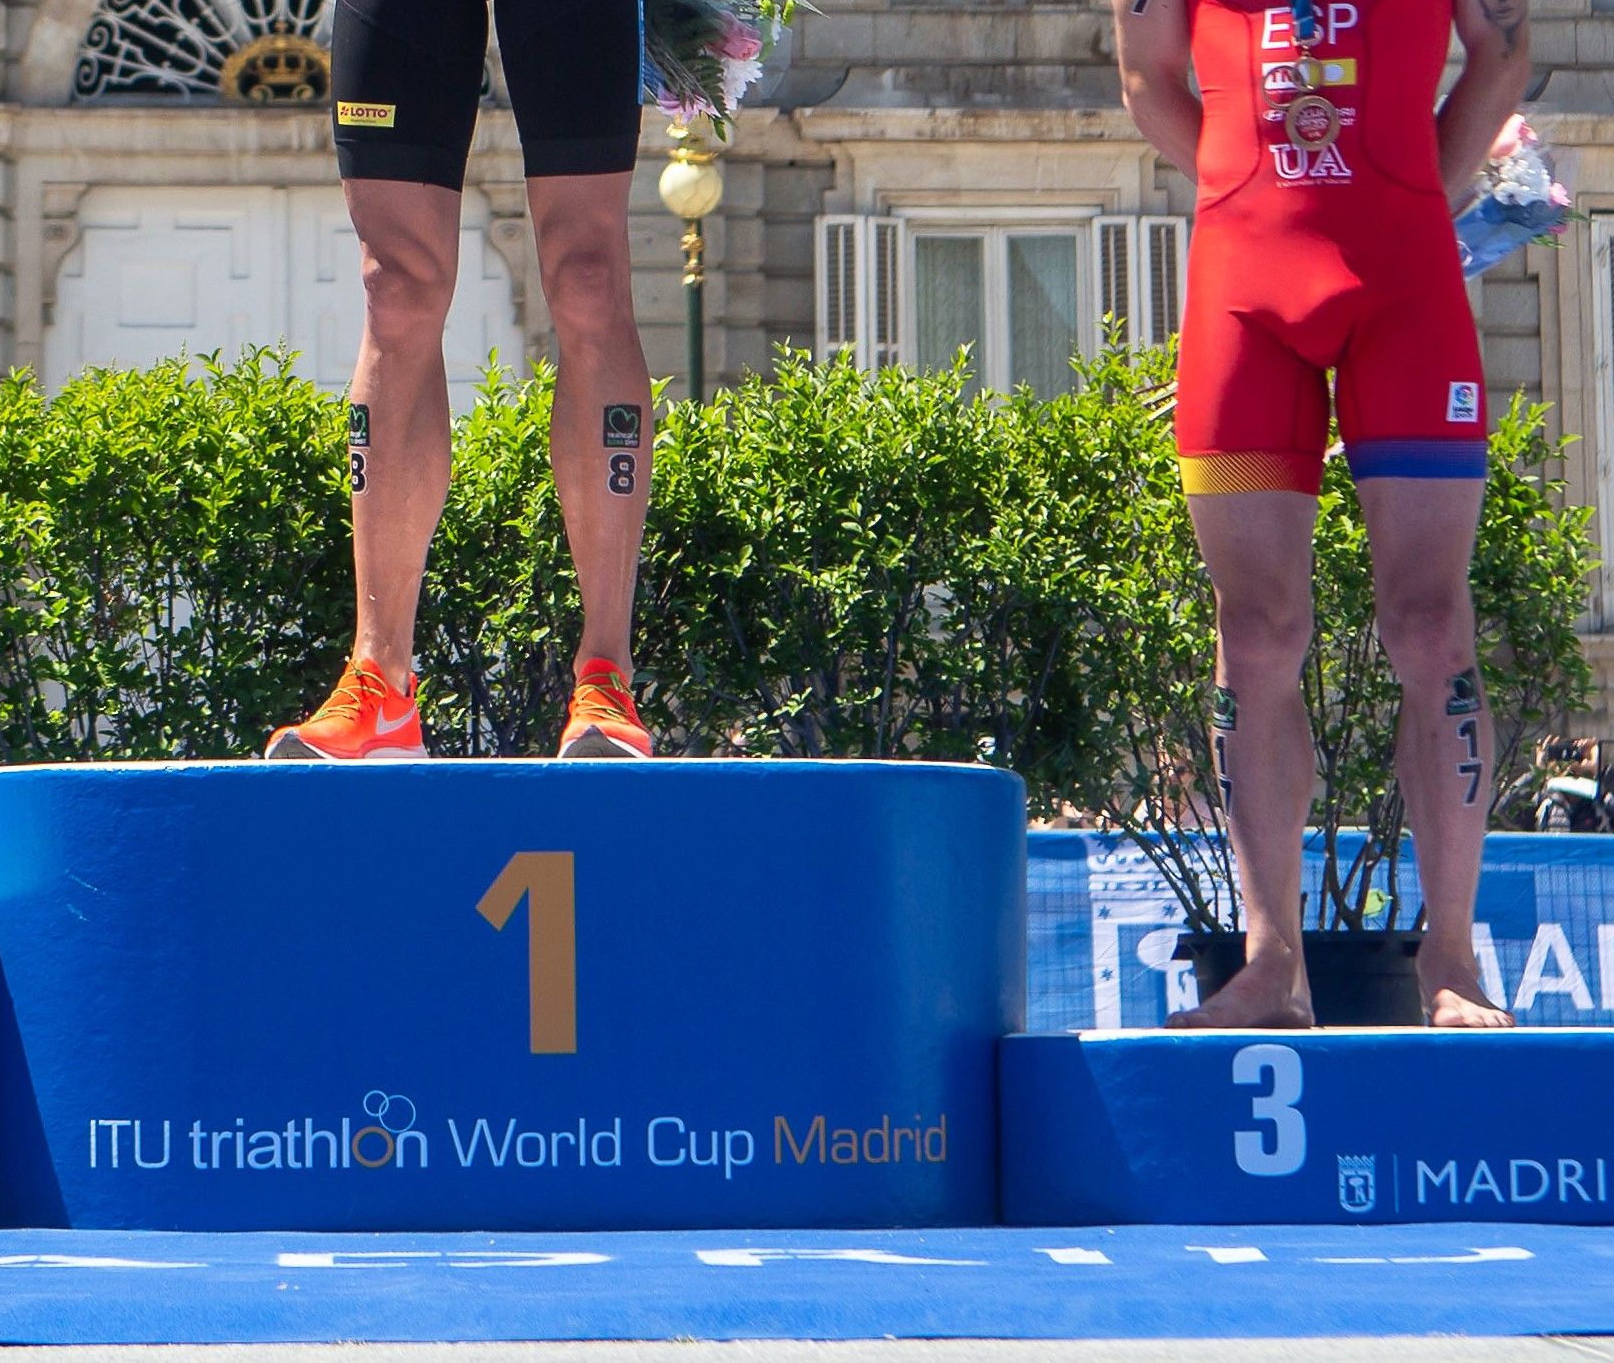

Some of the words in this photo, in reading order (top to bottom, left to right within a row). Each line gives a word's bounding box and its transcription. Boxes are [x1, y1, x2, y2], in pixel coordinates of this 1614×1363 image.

[350, 106, 389, 119] LOTTO
[349, 449, 368, 496] 8
[607, 451, 637, 497] 8
[475, 850, 578, 1055] 1
[1231, 1043, 1307, 1178] 3
[90, 1118, 171, 1169] ITU
[188, 1117, 429, 1171] triathlon
[446, 1116, 622, 1167] World
[646, 1116, 755, 1180] Cup
[772, 1113, 947, 1164] Madrid
